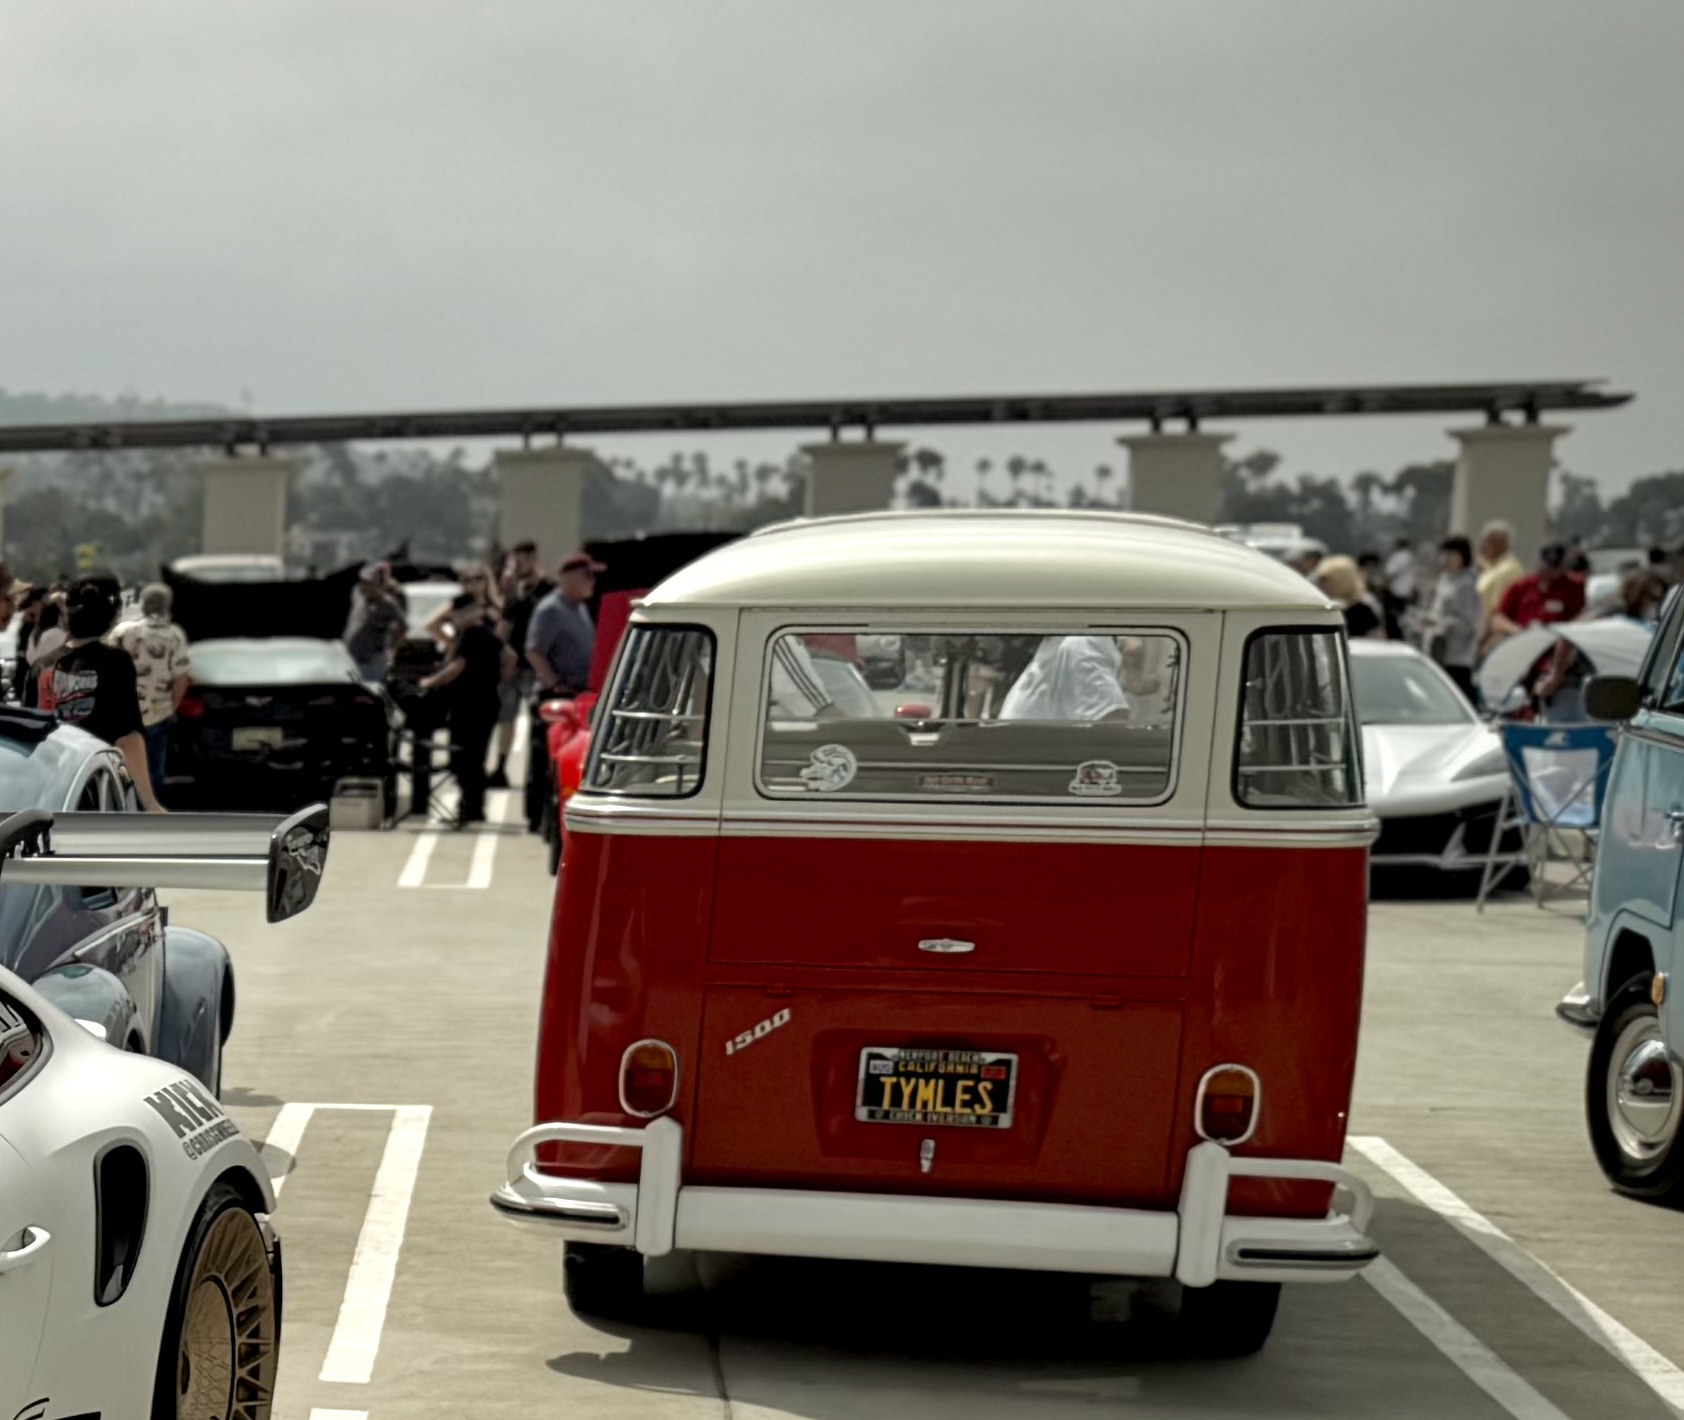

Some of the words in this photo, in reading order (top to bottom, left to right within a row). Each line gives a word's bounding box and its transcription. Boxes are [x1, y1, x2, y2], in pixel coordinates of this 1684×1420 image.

[726, 1007, 790, 1056] 1500
[898, 1062, 979, 1075] CALIFORNIA
[879, 1076, 993, 1114] TYMLES
